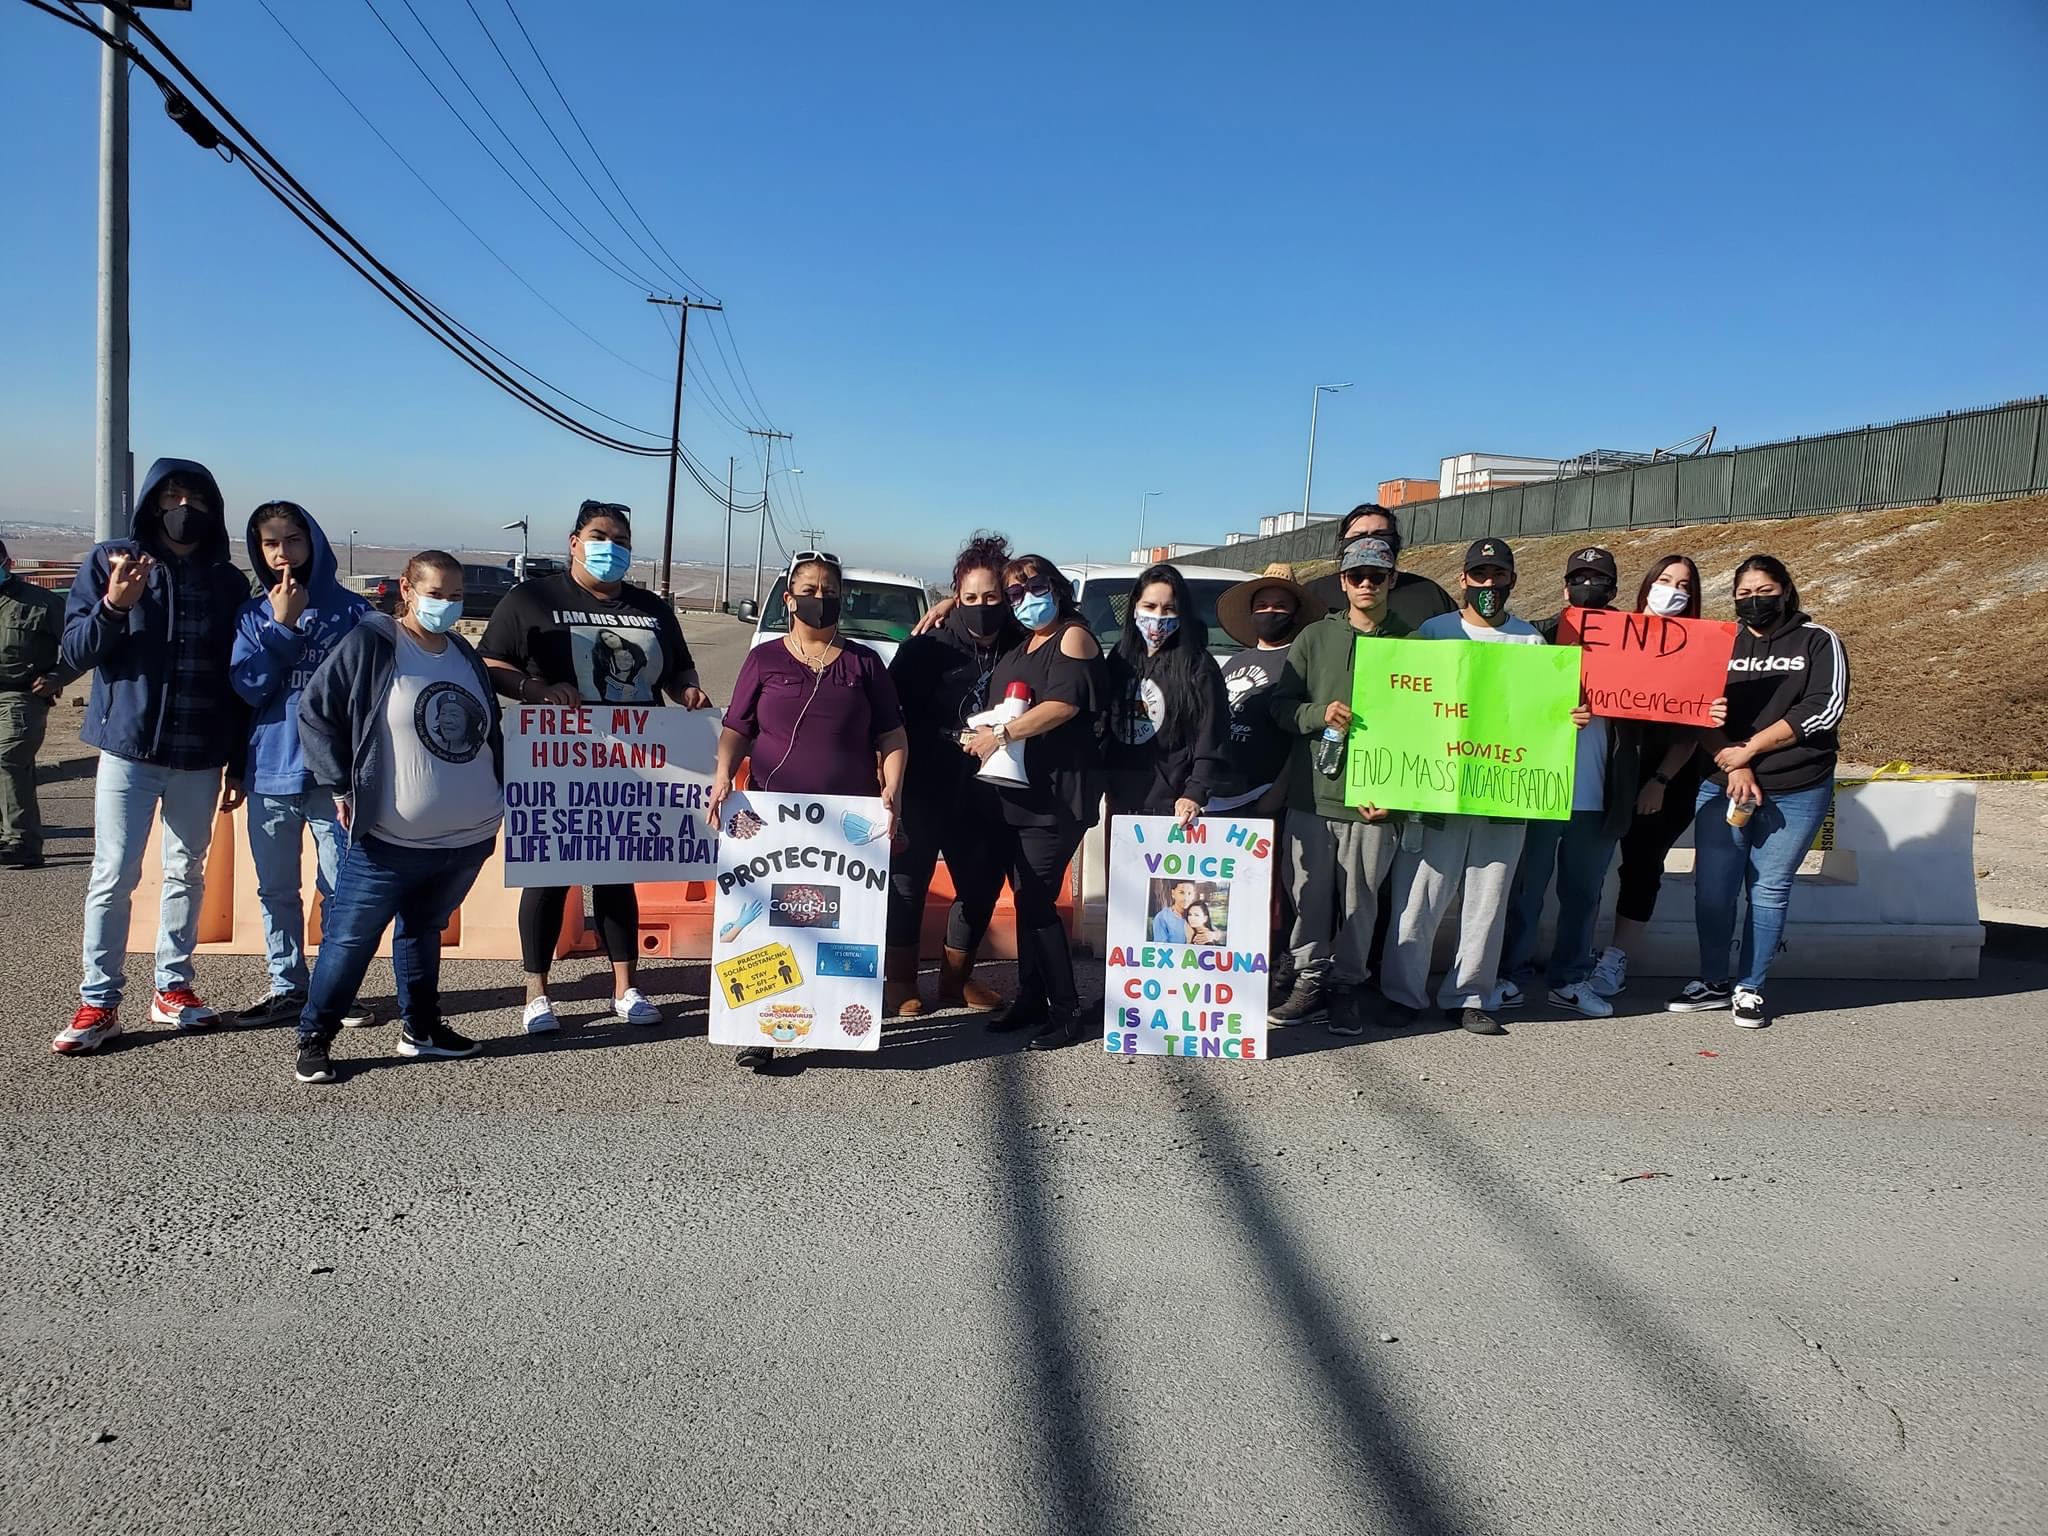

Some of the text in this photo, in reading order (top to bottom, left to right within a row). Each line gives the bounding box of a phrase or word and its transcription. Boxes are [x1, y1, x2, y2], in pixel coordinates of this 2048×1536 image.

[552, 610, 661, 631] I AM HIS VOICE
[1578, 610, 1688, 658] END
[1246, 664, 1270, 688] TOWN
[1390, 673, 1433, 692] FREE
[1584, 672, 1712, 718] hancement
[519, 708, 650, 736] FREE MY
[1433, 702, 1469, 719] THE
[532, 741, 667, 769] HUSBAND
[1447, 741, 1528, 764] HOMIES
[1352, 747, 1393, 788] END
[1400, 751, 1457, 792] MASS
[506, 780, 713, 809] OUR DAUGHTERS
[511, 809, 696, 840] DESERVES A
[778, 803, 825, 824] NO
[505, 835, 552, 863] LIFE
[558, 836, 610, 862] WITH
[615, 836, 674, 862] THEIR
[1134, 823, 1271, 859] I AM HIS
[1821, 821, 1835, 851] CROSS
[717, 847, 887, 895] PROTECTION
[1144, 853, 1236, 879] VOICE
[769, 899, 839, 914] Covid-19
[723, 950, 788, 978] SOCIAL DISTANCING
[737, 950, 769, 966] PRACTICE
[1108, 946, 1268, 973] ALEX ACUNA
[750, 970, 768, 981] STAY
[755, 982, 777, 995] APART
[1118, 1007, 1242, 1034] IS A LIFE
